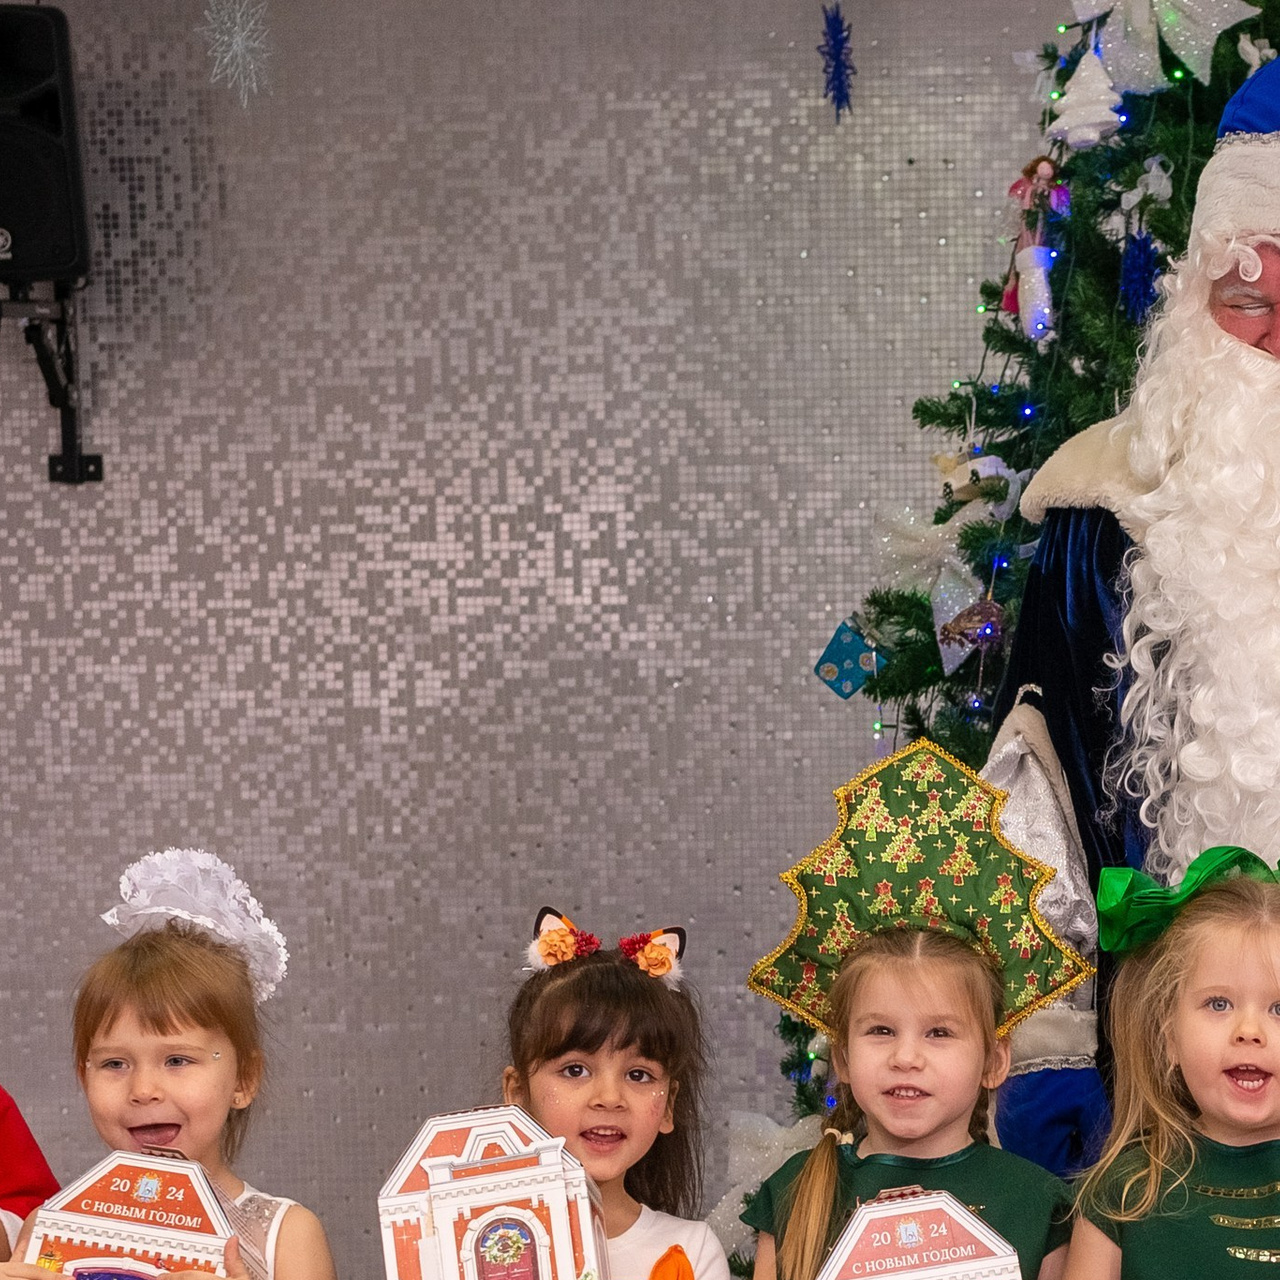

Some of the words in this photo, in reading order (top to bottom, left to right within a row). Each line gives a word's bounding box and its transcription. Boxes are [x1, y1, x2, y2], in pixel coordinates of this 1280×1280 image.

[110, 1177, 131, 1192] 20
[166, 1186, 185, 1201] 24
[81, 1199, 91, 1210] С
[93, 1201, 146, 1219] НОВЫМ
[148, 1209, 202, 1228] ГОДОМ!
[871, 1231, 891, 1246] 20
[929, 1222, 948, 1237] 24
[852, 1263, 862, 1274] С
[865, 1253, 920, 1273] НОВЫМ
[923, 1244, 977, 1263] ГОДОМ!
